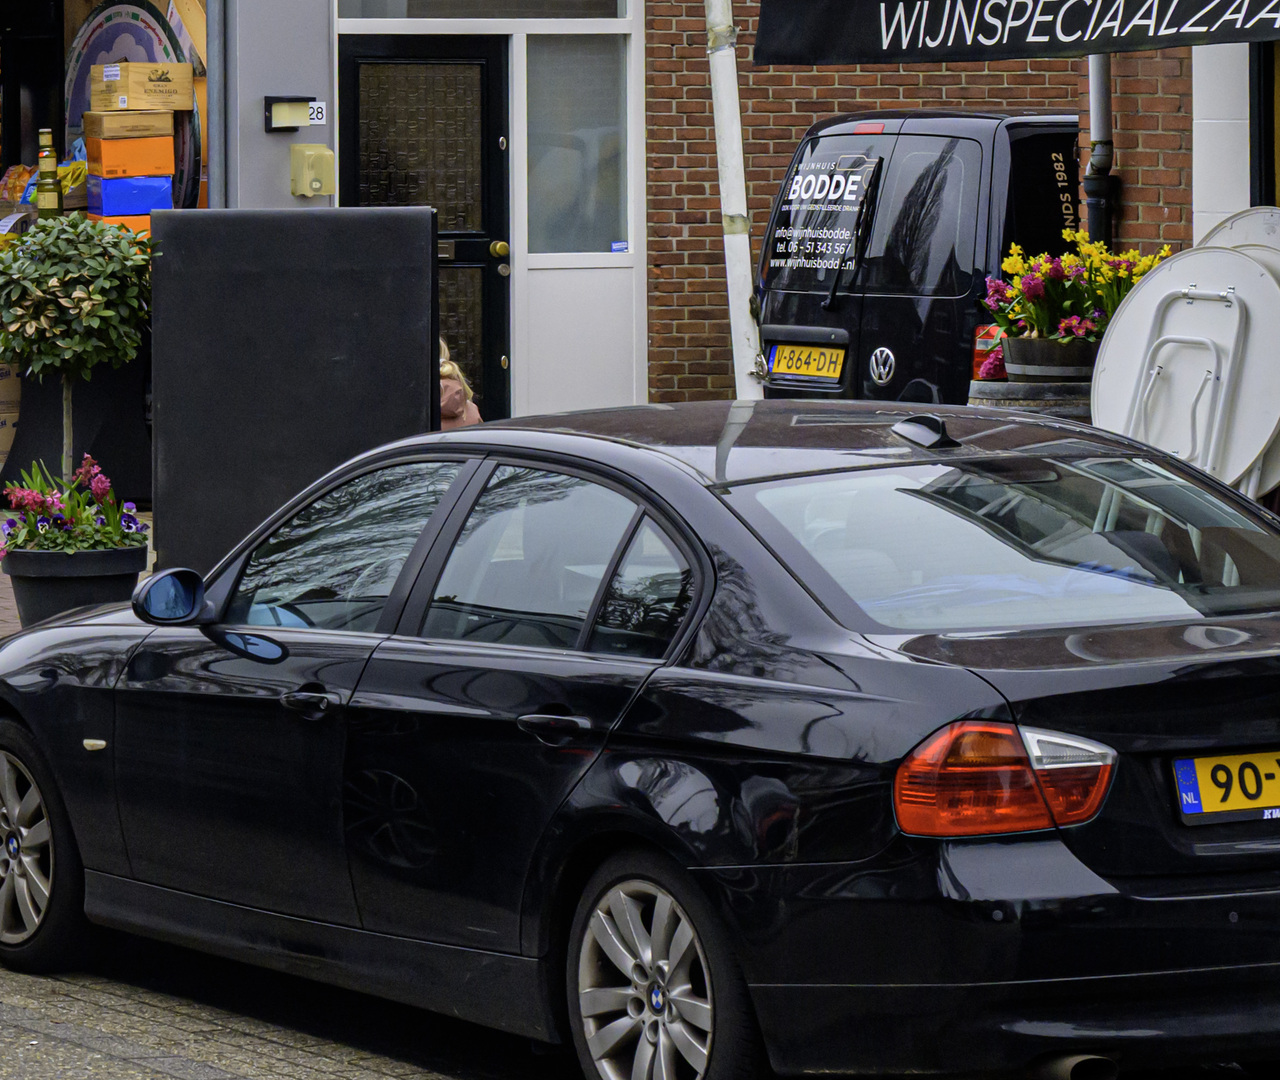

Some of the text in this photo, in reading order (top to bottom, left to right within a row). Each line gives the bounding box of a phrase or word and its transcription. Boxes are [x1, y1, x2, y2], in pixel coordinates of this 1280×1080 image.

[309, 106, 324, 120] 28
[798, 162, 837, 171] WIJNHUIS
[788, 174, 862, 201] BODDE
[1059, 193, 1076, 232] INDS
[787, 241, 799, 253] 06
[805, 241, 815, 253] 51
[815, 242, 833, 254] 343
[770, 256, 856, 270] www.wijnhuisbodd.nl
[776, 349, 840, 374] V-864-DH
[1210, 758, 1280, 804] 90-
[1181, 792, 1199, 805] NL
